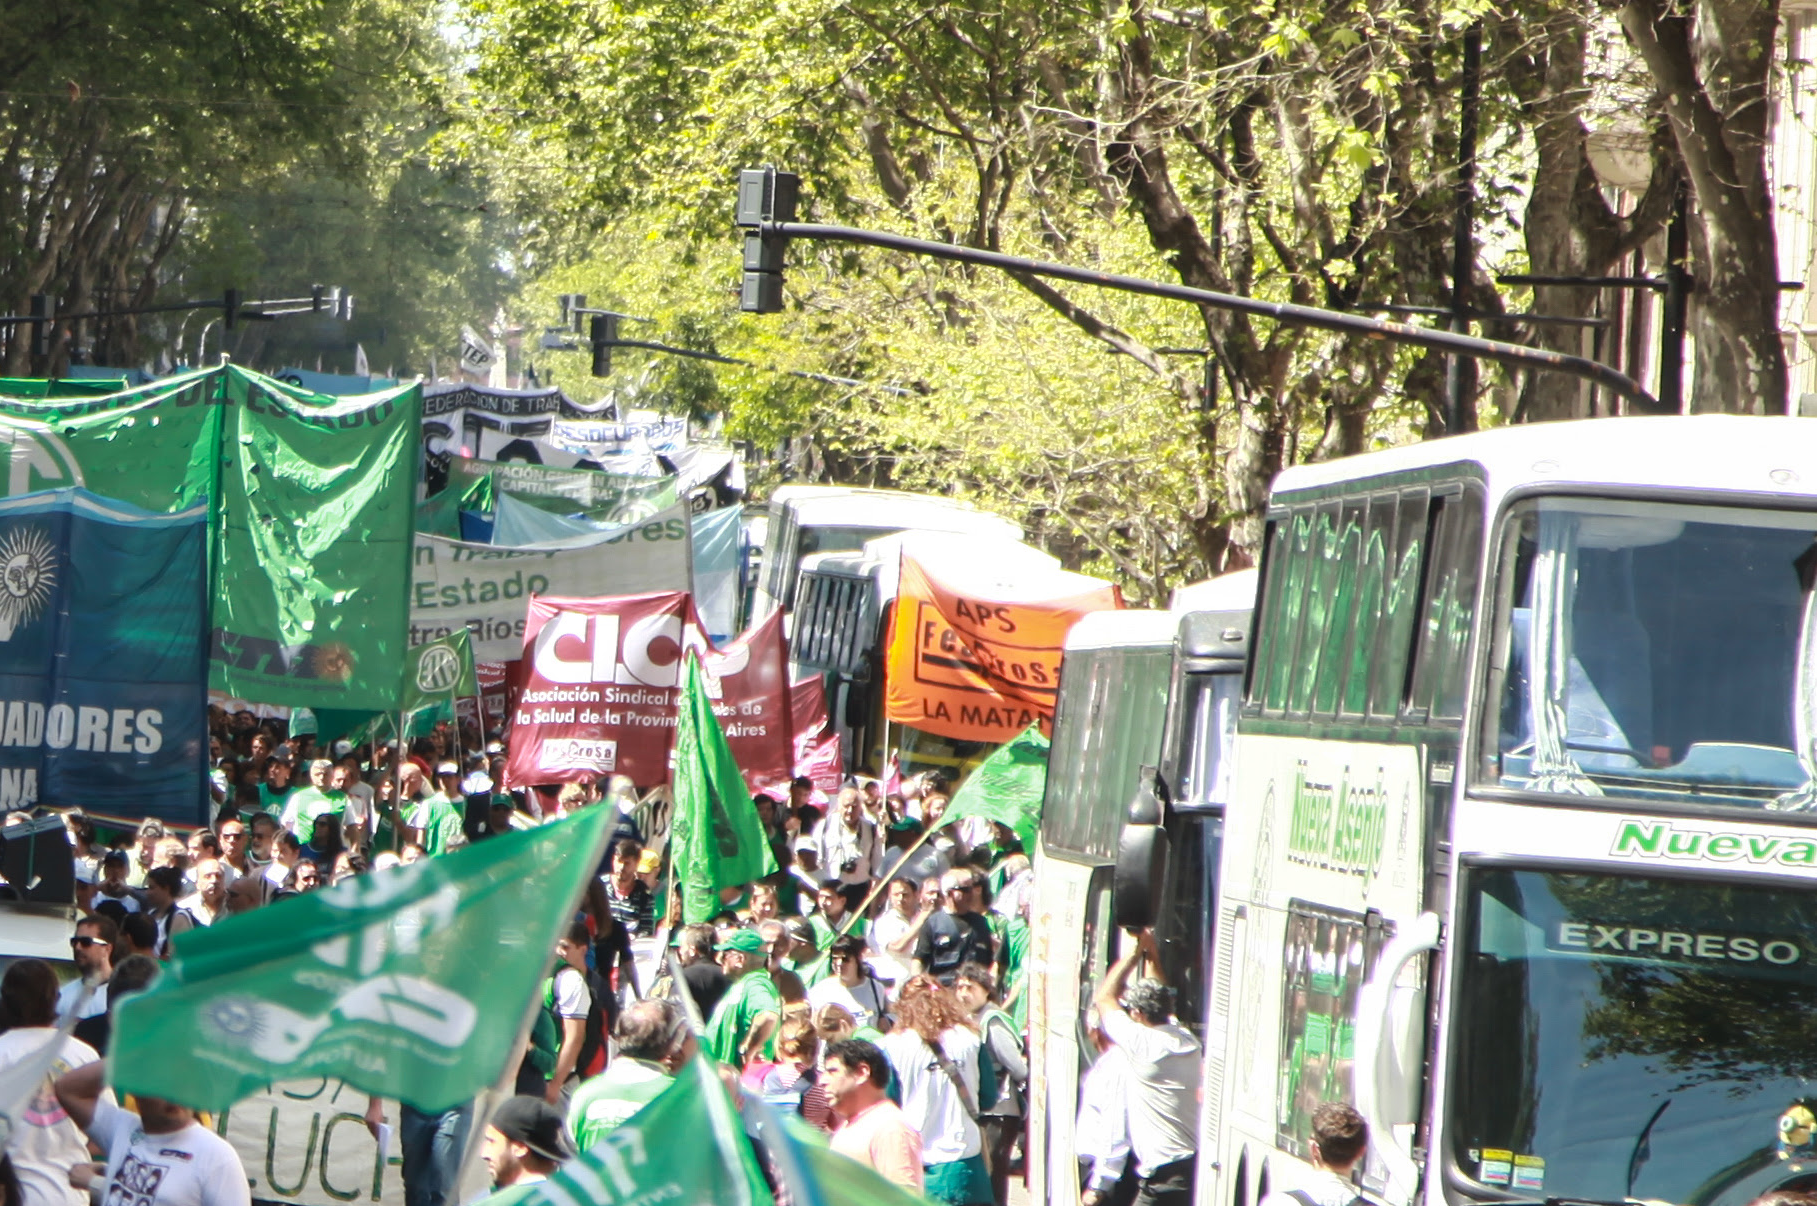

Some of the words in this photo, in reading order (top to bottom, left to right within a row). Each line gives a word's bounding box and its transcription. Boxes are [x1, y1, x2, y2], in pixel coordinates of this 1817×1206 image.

[416, 570, 549, 609] Estado
[957, 599, 1016, 633] APS
[521, 687, 600, 703] Asociación
[605, 689, 669, 706] Sindical
[534, 708, 575, 724] Salud
[579, 708, 600, 724] de
[923, 698, 951, 722] LA
[726, 724, 767, 738] Aires
[1559, 921, 1800, 967] EXPRESO
